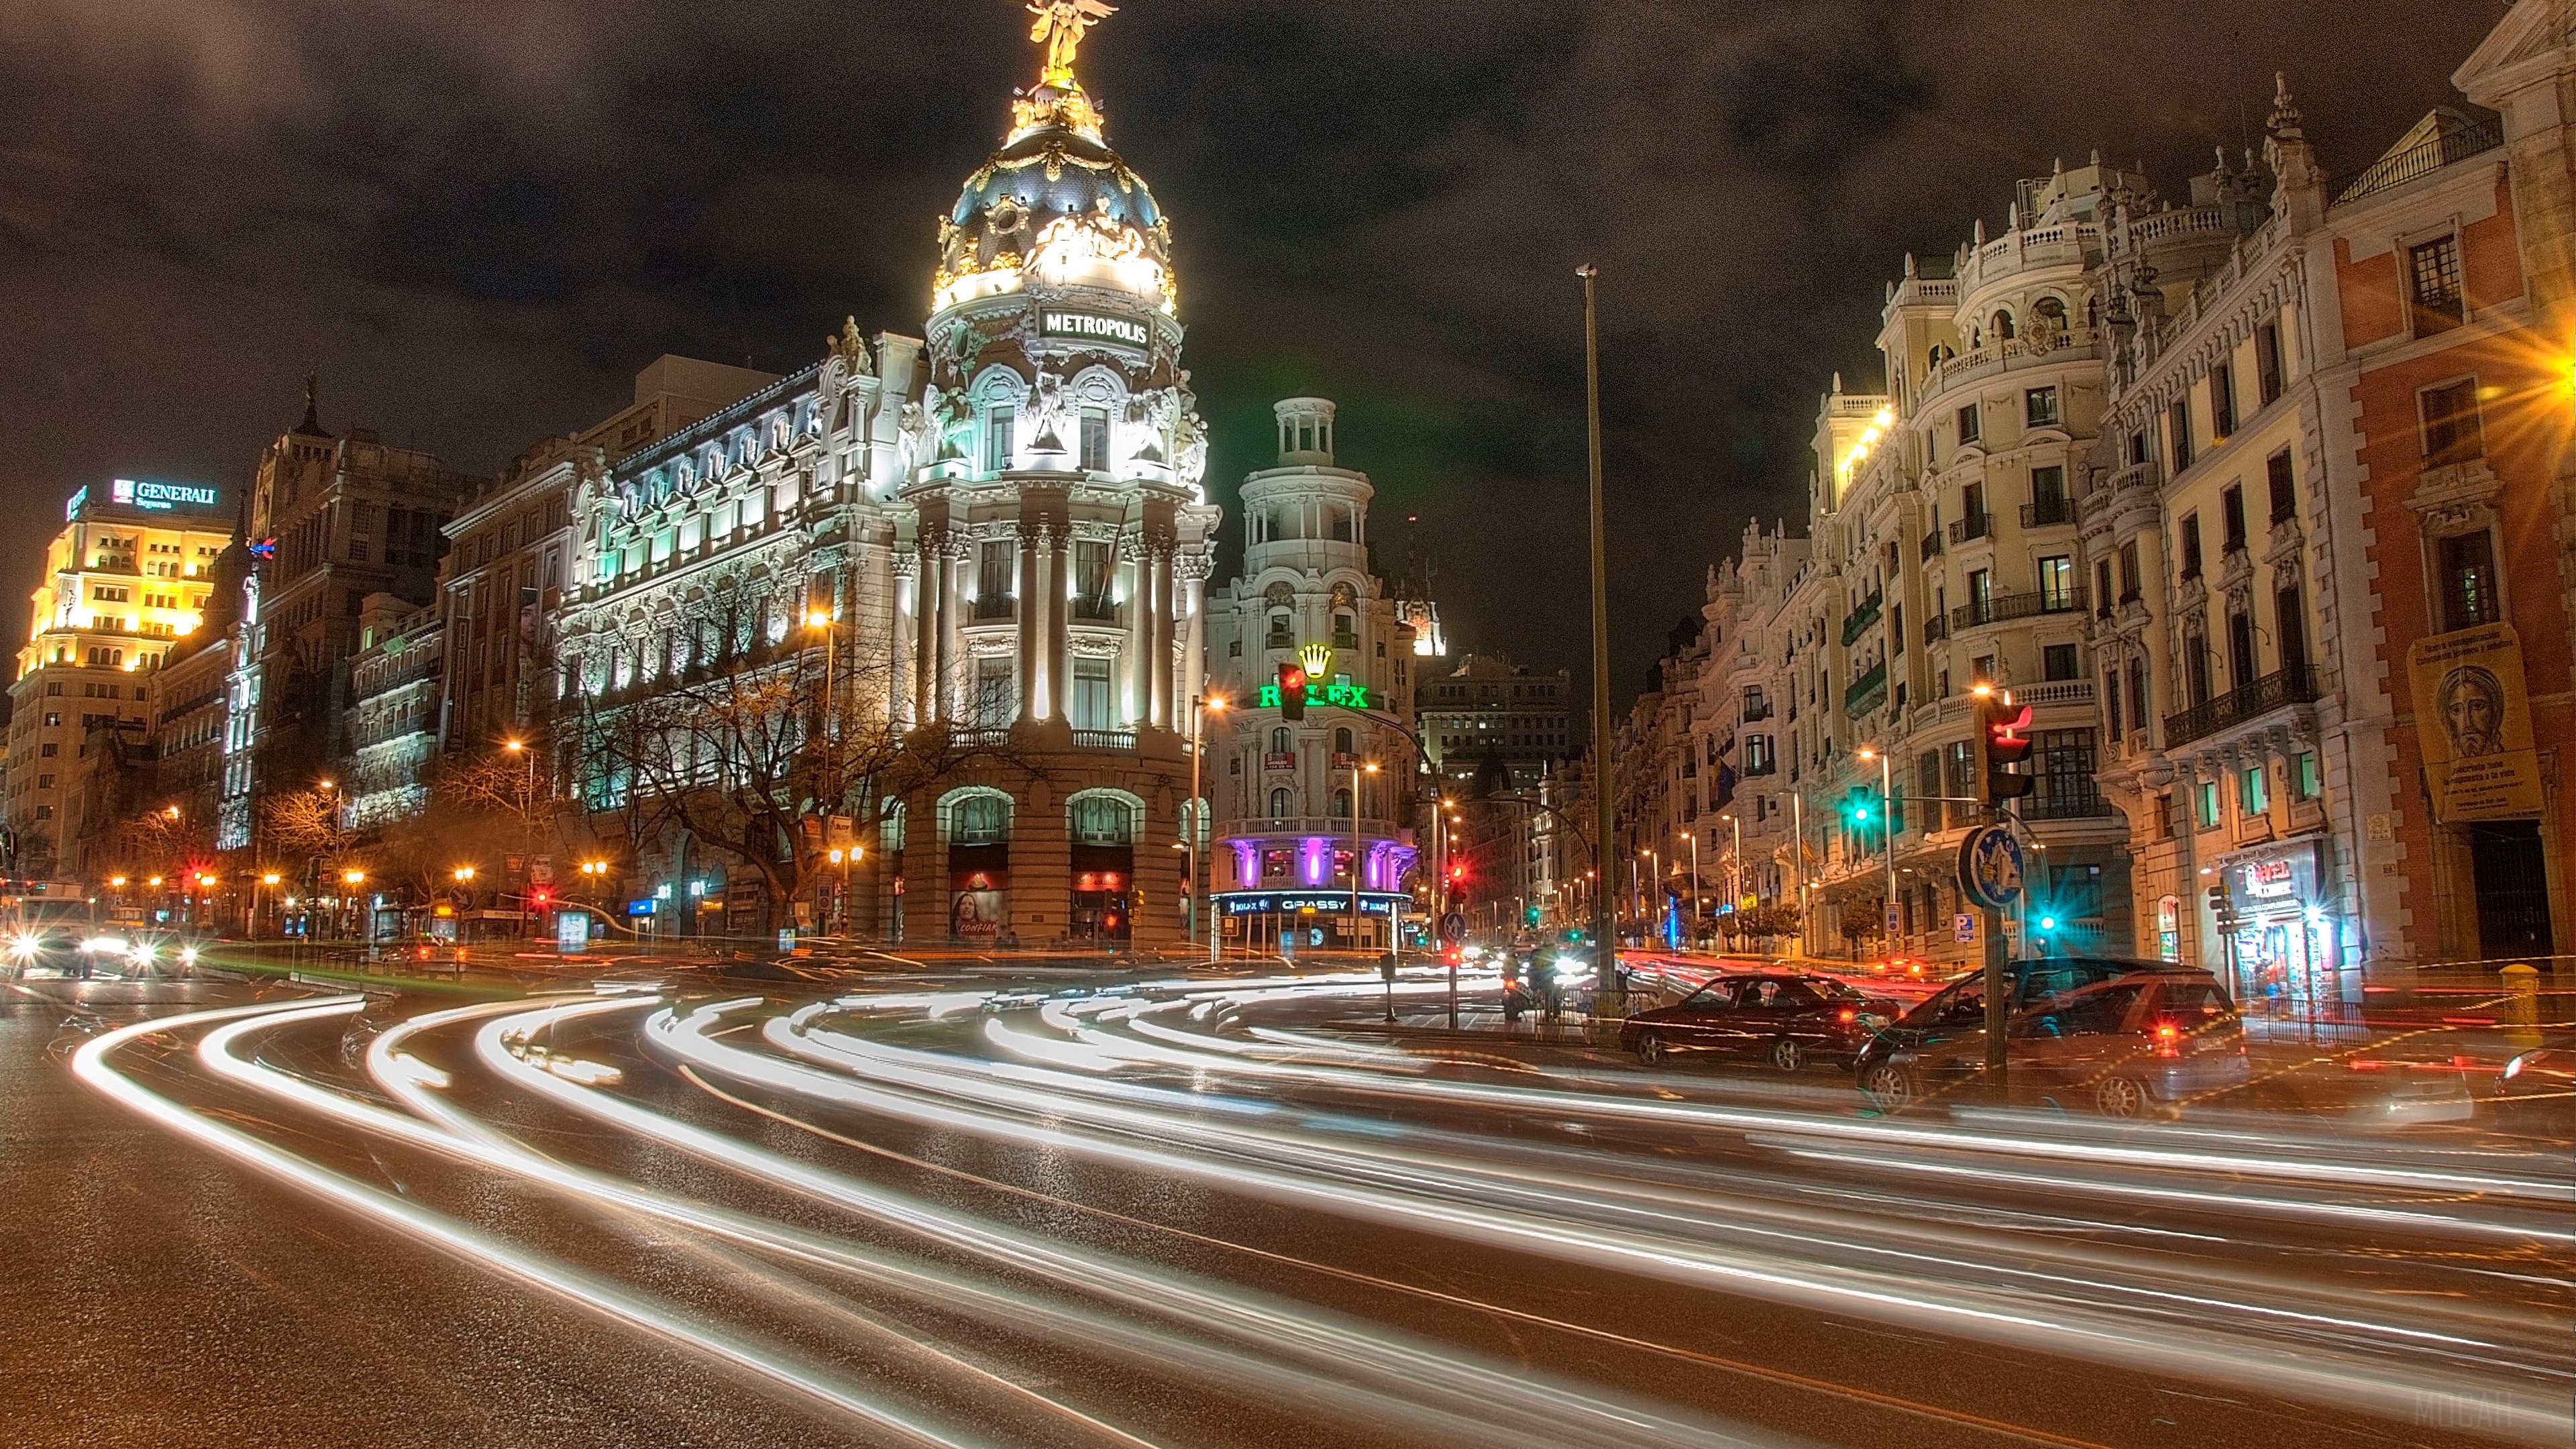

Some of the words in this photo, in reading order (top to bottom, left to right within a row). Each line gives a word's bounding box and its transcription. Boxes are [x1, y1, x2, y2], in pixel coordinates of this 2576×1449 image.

[1047, 314, 1146, 343] METROPOLIS
[138, 482, 216, 504] GENERALI
[136, 497, 172, 510] Seguros
[1259, 685, 1368, 708] RLEX
[1282, 900, 1347, 909] GRASSY
[960, 923, 997, 932] CONFIAR
